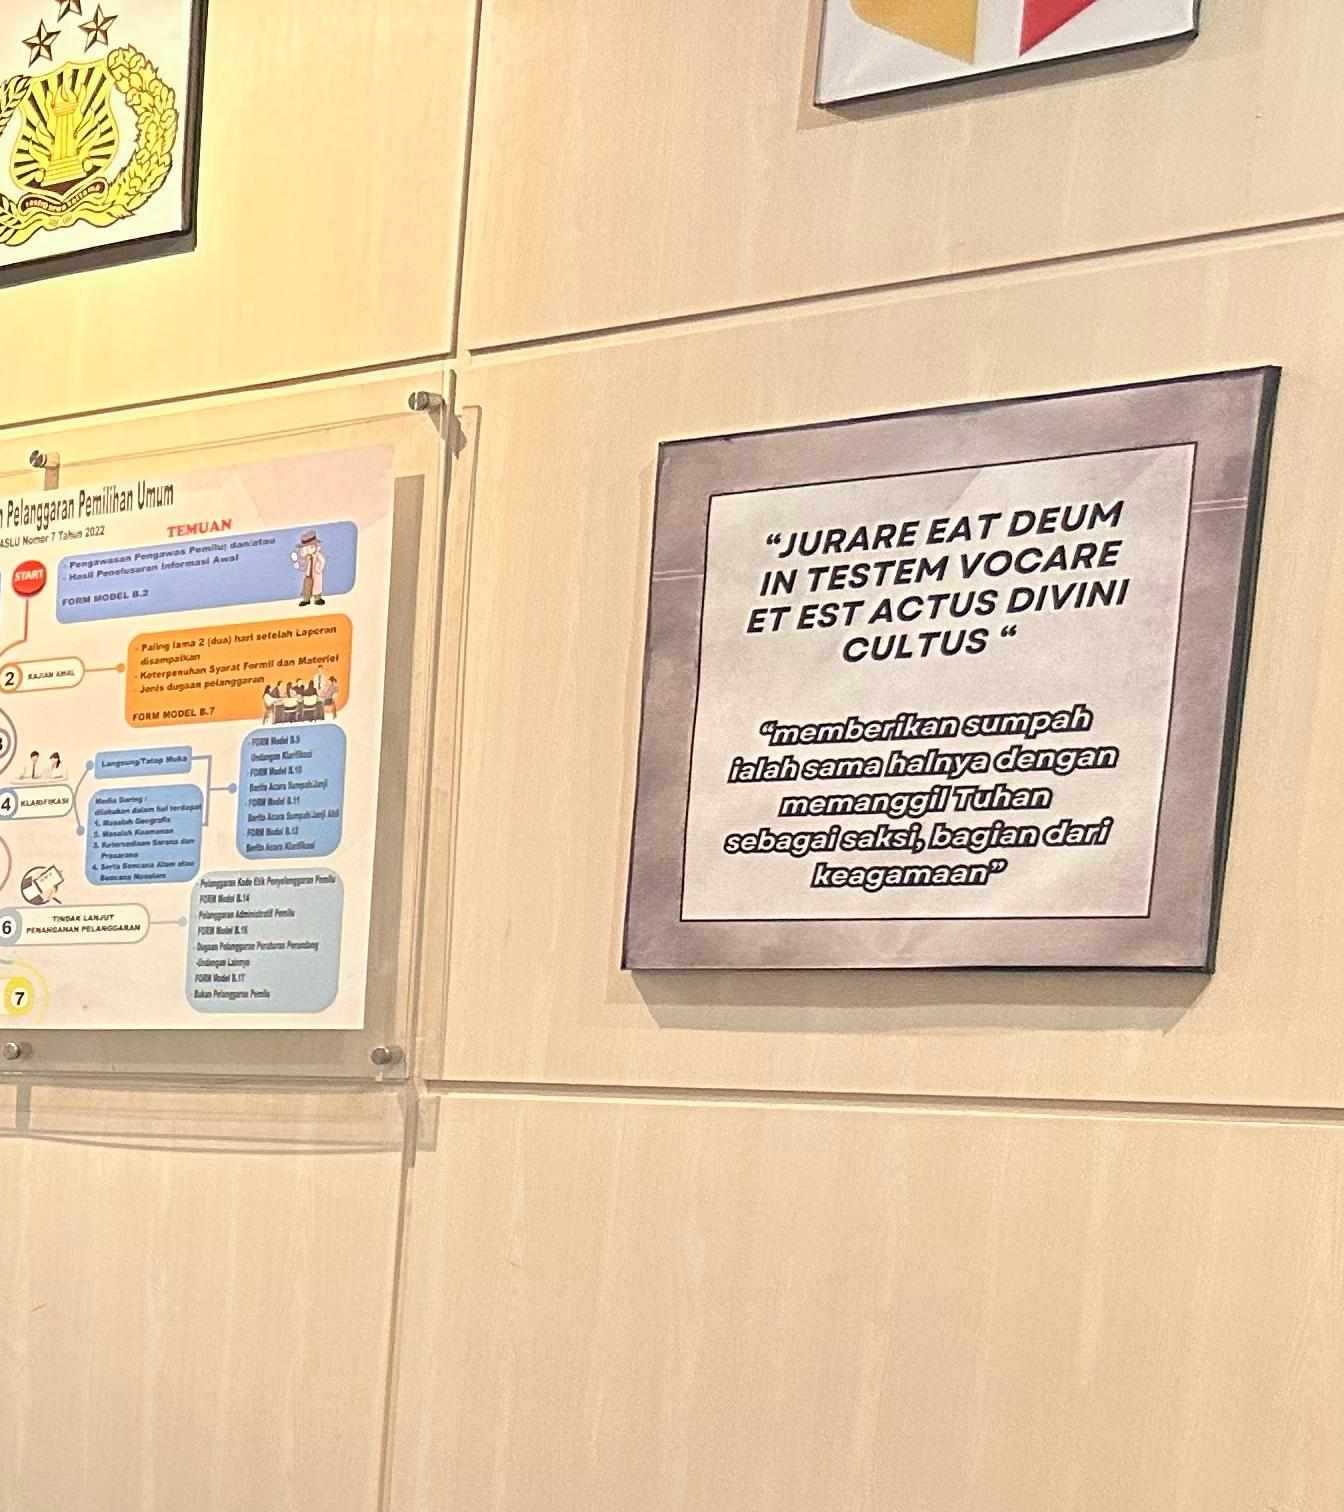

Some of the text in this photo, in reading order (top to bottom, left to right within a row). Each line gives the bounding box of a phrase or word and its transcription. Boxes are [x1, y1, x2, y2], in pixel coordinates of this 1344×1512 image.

[7, 498, 75, 531] Pelanggaran
[79, 485, 134, 518] Pemilihan
[138, 481, 174, 509] Umum
[167, 518, 232, 538] TEMUAN
[765, 501, 1124, 559] “JURARE EAT DEUM
[16, 568, 42, 580] START
[761, 541, 1122, 596] IN TESTEM VOCARE
[62, 596, 91, 607] FORM
[94, 591, 130, 604] MODEL
[746, 579, 1129, 634] ET EST ACTUS DIVINI
[141, 642, 170, 652] Paling
[172, 640, 196, 649] lama
[198, 638, 205, 647] 2
[234, 633, 254, 643] hari
[257, 630, 293, 641] setelah
[296, 626, 337, 638] Laporan
[842, 629, 988, 663] CULTUS
[140, 653, 201, 666] disampaikan
[5, 672, 15, 686] 2
[139, 675, 265, 694] Jenis dugaan pelanggaran
[133, 712, 160, 722] FORM
[162, 709, 196, 719] MODEL
[759, 705, 1092, 747] “memberikan sumpah
[728, 743, 1118, 783] ialah sama halnya dengan
[1, 797, 11, 810] 4
[778, 786, 1052, 820] memanggil Tuhan
[724, 817, 1113, 856] sebagai saksi, bagian dari
[810, 859, 1006, 892] keagamaan”
[2, 921, 12, 934] 6
[82, 924, 141, 932] PELANGGARAN
[83, 914, 114, 922] LANJUT
[14, 991, 25, 1005] 7
